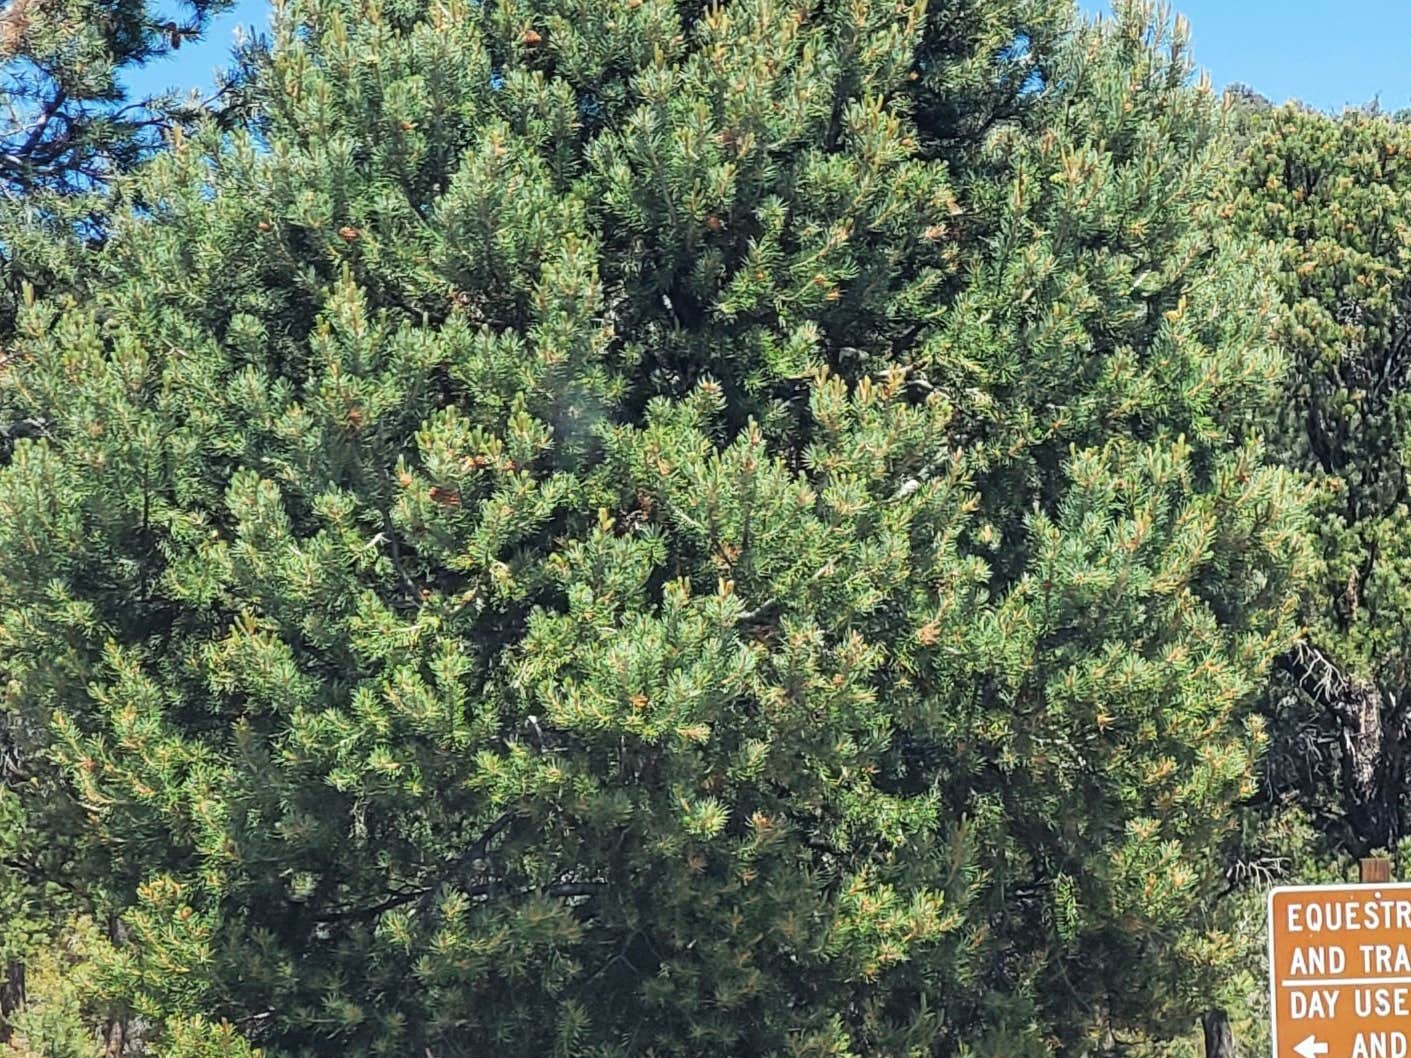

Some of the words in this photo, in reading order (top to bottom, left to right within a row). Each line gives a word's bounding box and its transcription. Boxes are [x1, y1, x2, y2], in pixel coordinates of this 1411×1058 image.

[1290, 946, 1346, 975] AND
[1290, 990, 1340, 1019] DAY
[1355, 988, 1409, 1017] USE
